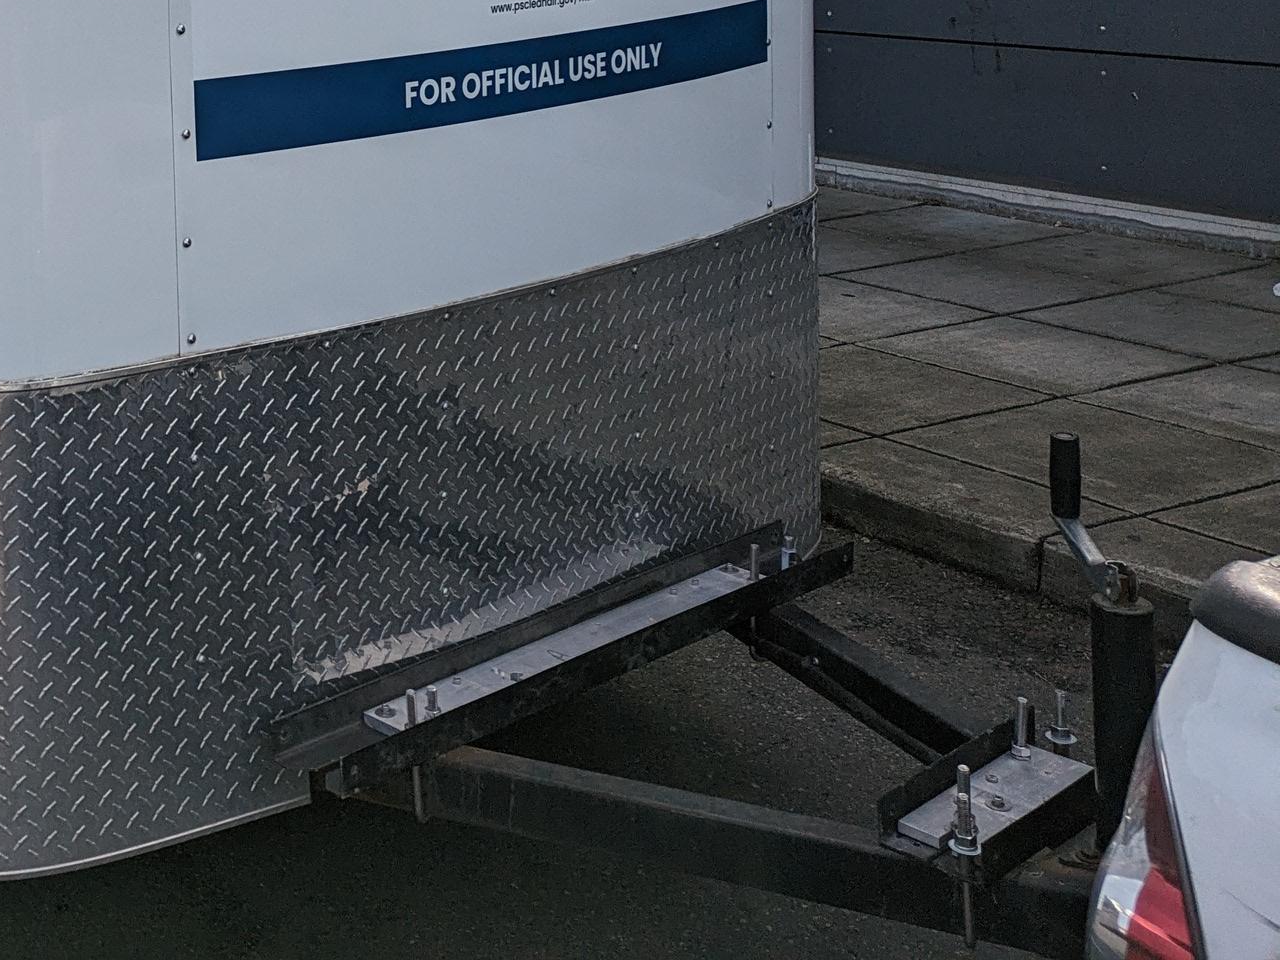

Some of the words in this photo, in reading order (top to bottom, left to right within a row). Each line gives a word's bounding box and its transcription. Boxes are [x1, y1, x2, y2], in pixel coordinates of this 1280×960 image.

[404, 75, 457, 109] FOR
[461, 58, 565, 100] OFFICIAL
[568, 51, 607, 82] USE
[610, 41, 663, 75] ONLY
